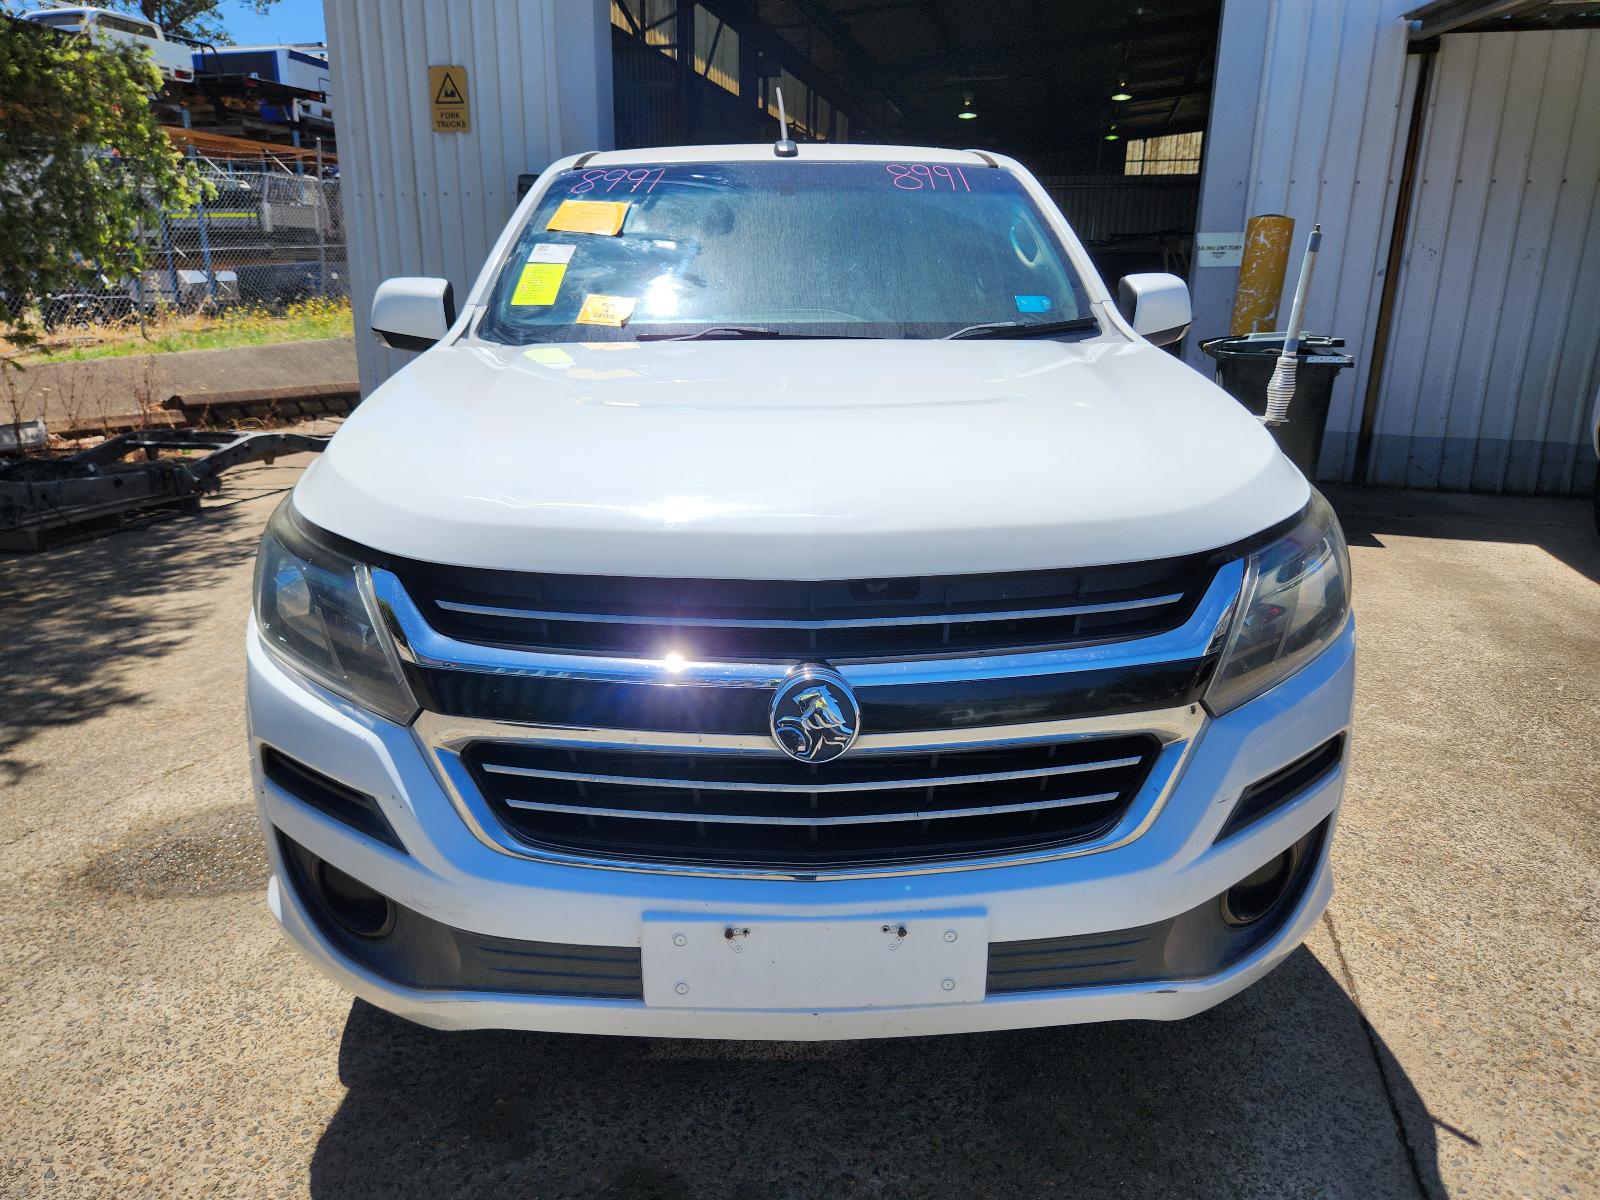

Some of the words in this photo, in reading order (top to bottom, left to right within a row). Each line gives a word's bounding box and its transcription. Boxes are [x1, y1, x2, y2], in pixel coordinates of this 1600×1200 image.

[437, 120, 467, 129] TRUCKS
[440, 112, 461, 120] FORK
[570, 168, 666, 194] 8991
[886, 164, 971, 193] 8991
